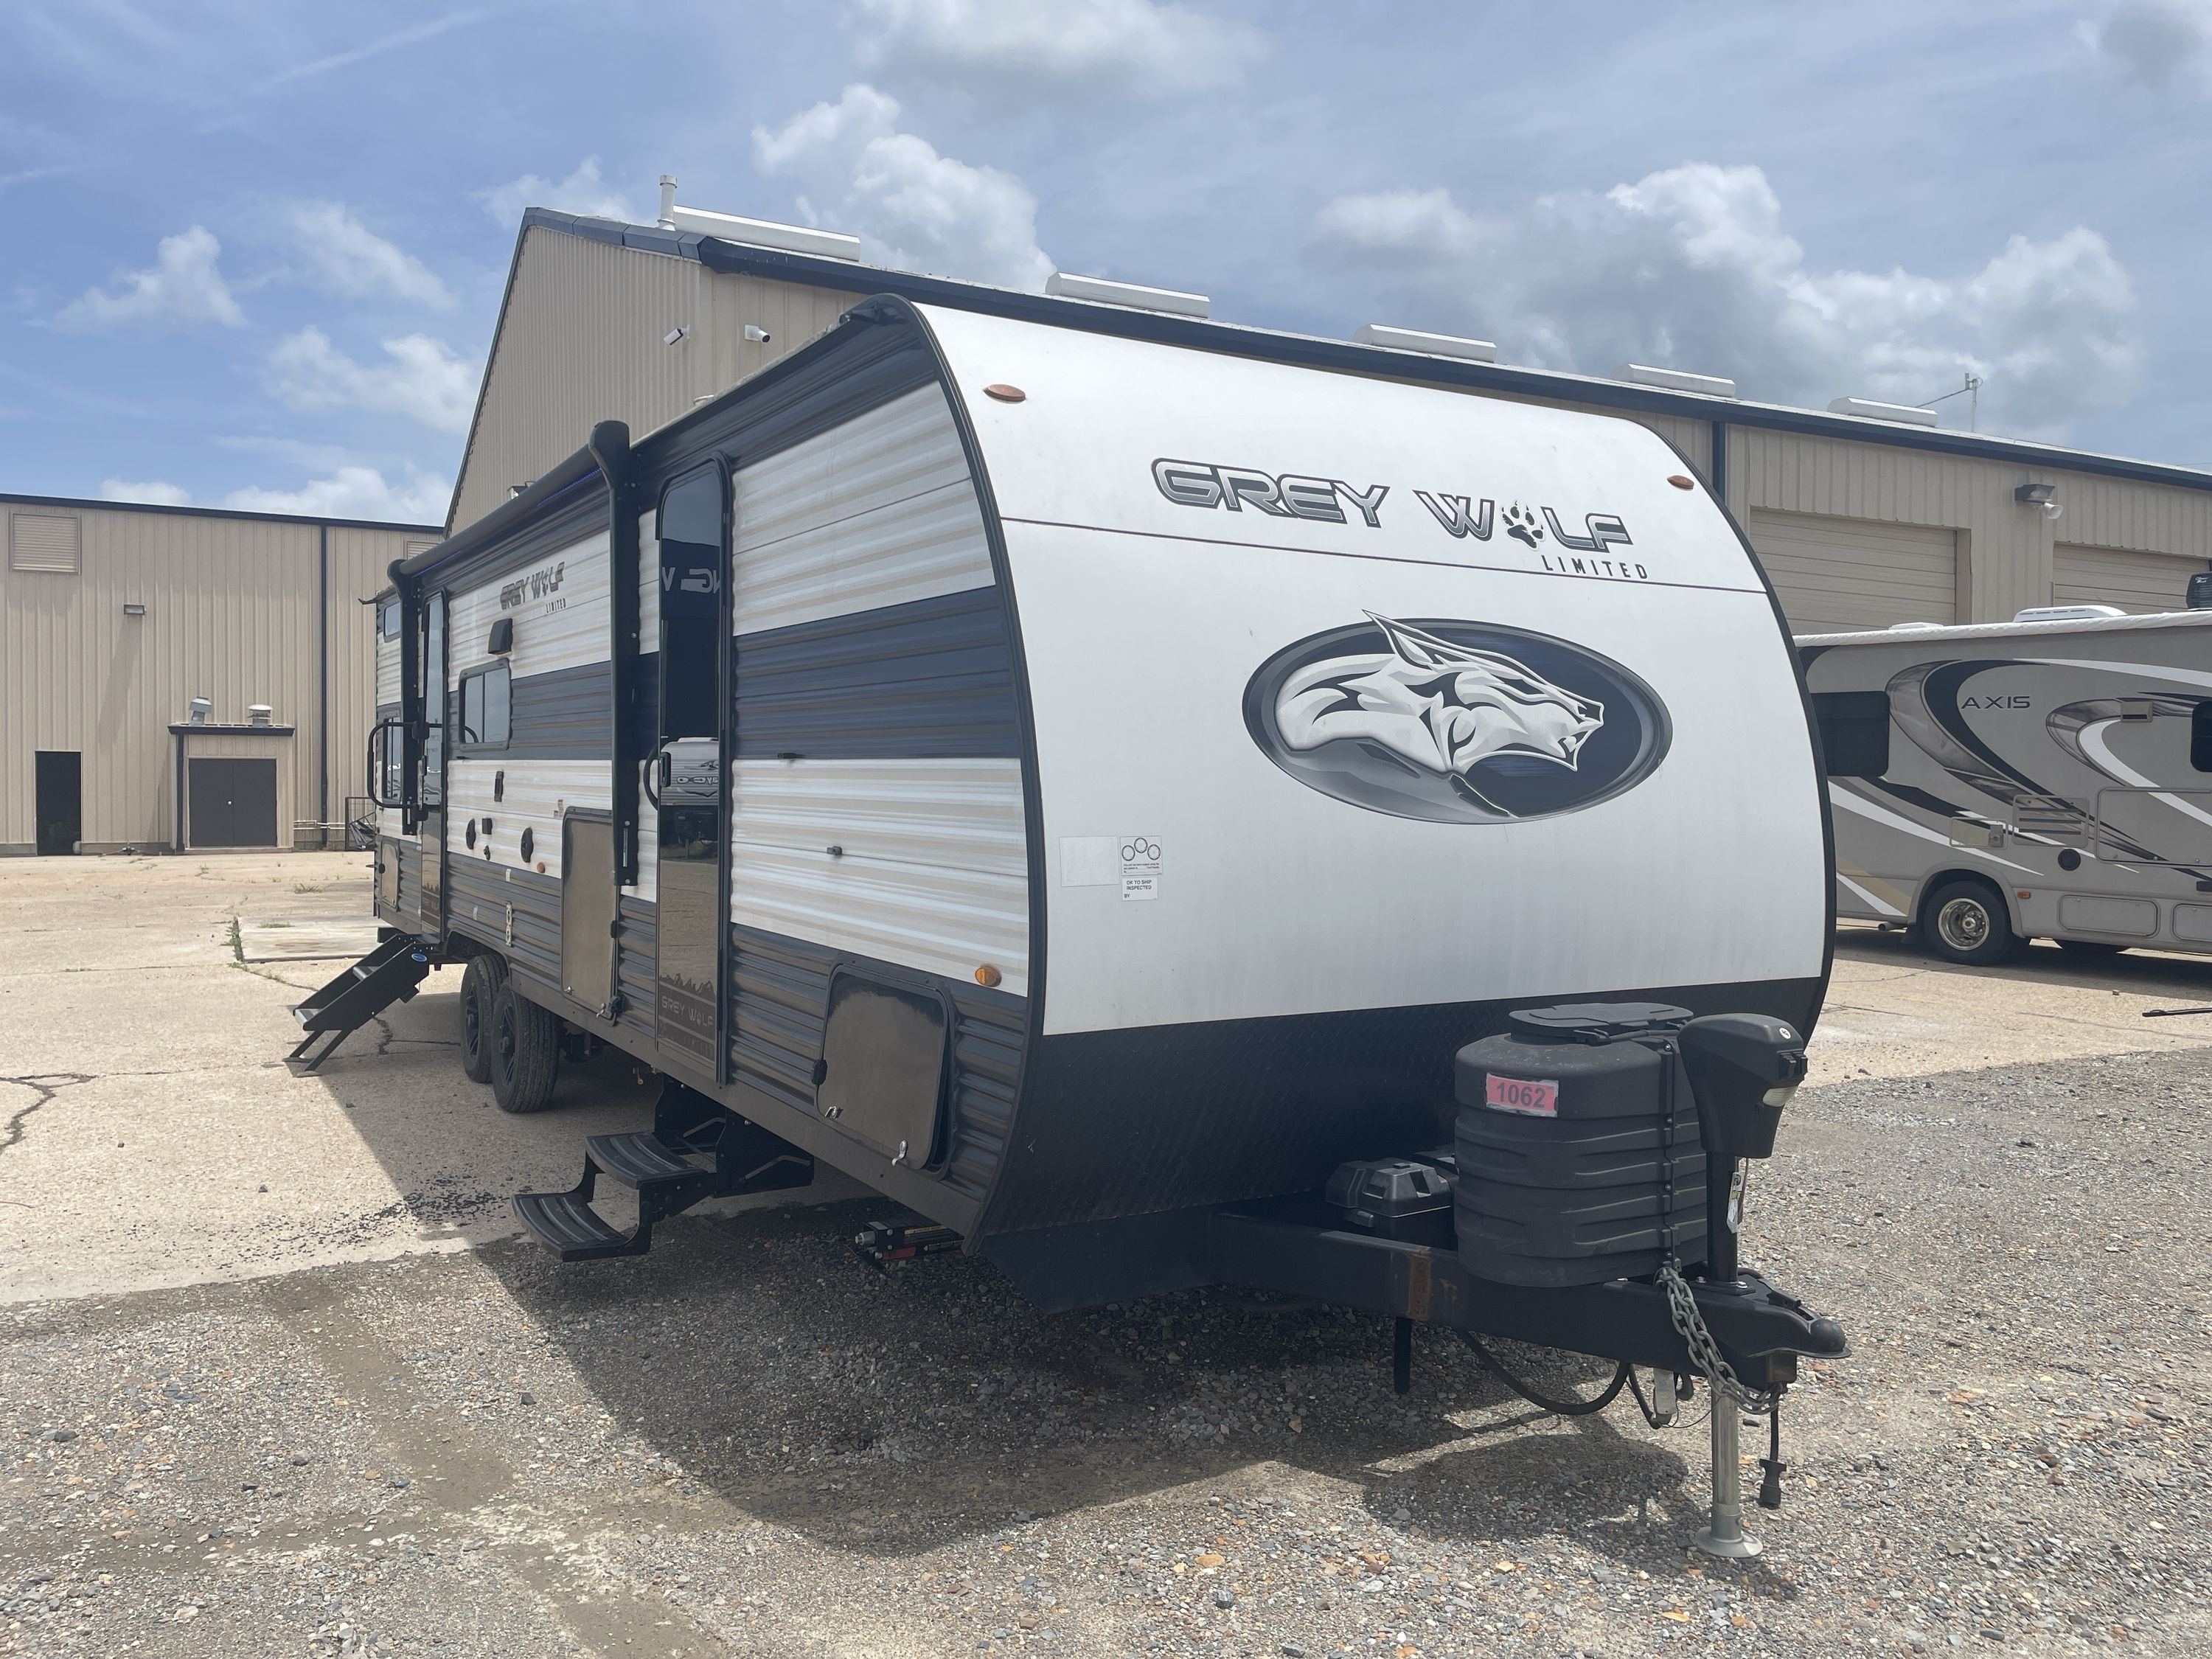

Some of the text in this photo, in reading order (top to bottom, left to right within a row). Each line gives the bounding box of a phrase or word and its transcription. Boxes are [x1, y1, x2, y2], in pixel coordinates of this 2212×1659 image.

[1151, 458, 1390, 528] GREY
[1542, 554, 1648, 580] LIMITED
[500, 577, 529, 610] GREY
[546, 597, 566, 613] LIMITED
[1961, 695, 2031, 709] AXIS
[661, 995, 685, 1015] GREY
[1497, 1082, 1546, 1108] 1062
